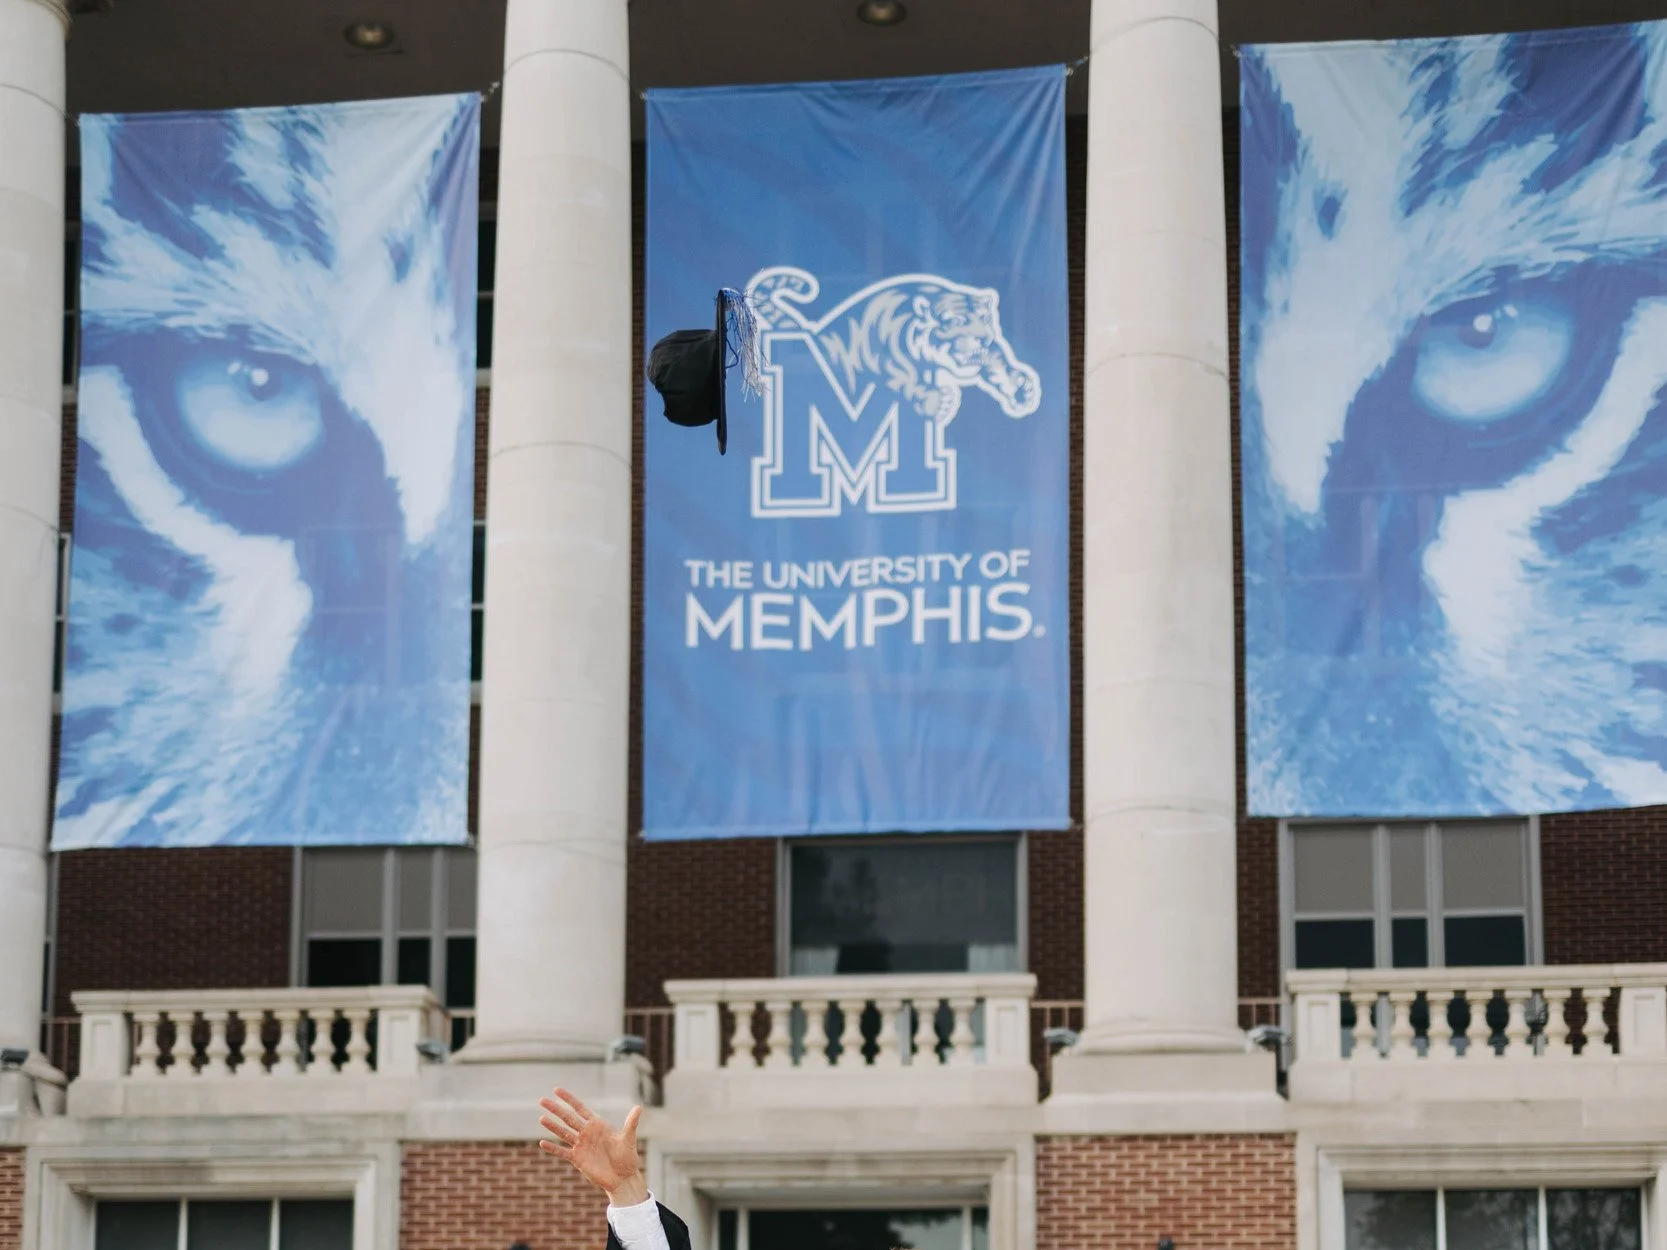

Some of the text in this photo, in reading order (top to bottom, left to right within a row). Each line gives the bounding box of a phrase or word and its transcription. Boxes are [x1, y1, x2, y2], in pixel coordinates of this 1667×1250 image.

[684, 549, 1031, 589] THE UNIVERSITY OF
